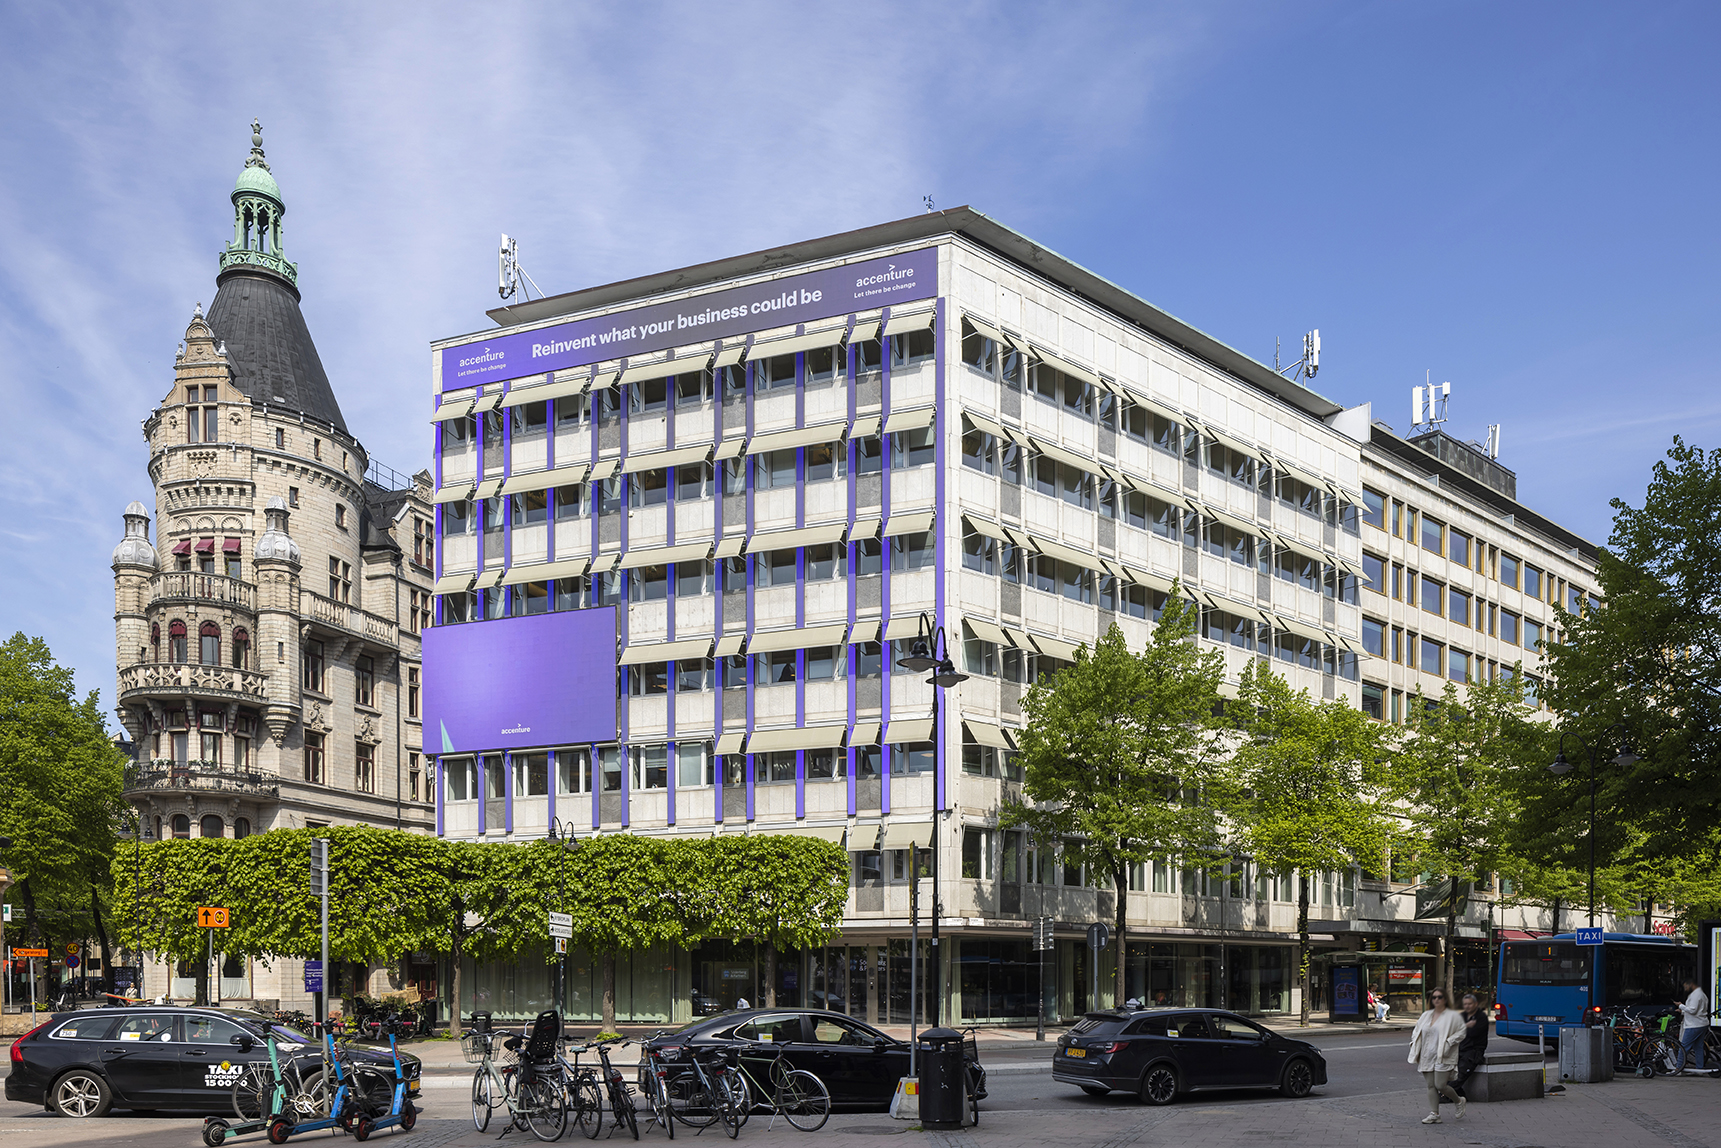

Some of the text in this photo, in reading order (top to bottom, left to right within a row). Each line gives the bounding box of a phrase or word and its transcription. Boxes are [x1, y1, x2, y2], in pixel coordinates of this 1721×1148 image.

[856, 267, 914, 288] accenture
[865, 288, 882, 297] there
[892, 281, 917, 291] change
[532, 288, 823, 358] Reinvent what your business could be
[459, 350, 505, 367] accenture
[487, 363, 507, 372] change
[501, 725, 531, 735] accenture
[1578, 932, 1602, 941] TAXI
[1548, 947, 1552, 955] 1
[208, 1064, 243, 1075] TAXI
[232, 1079, 248, 1087] 0
